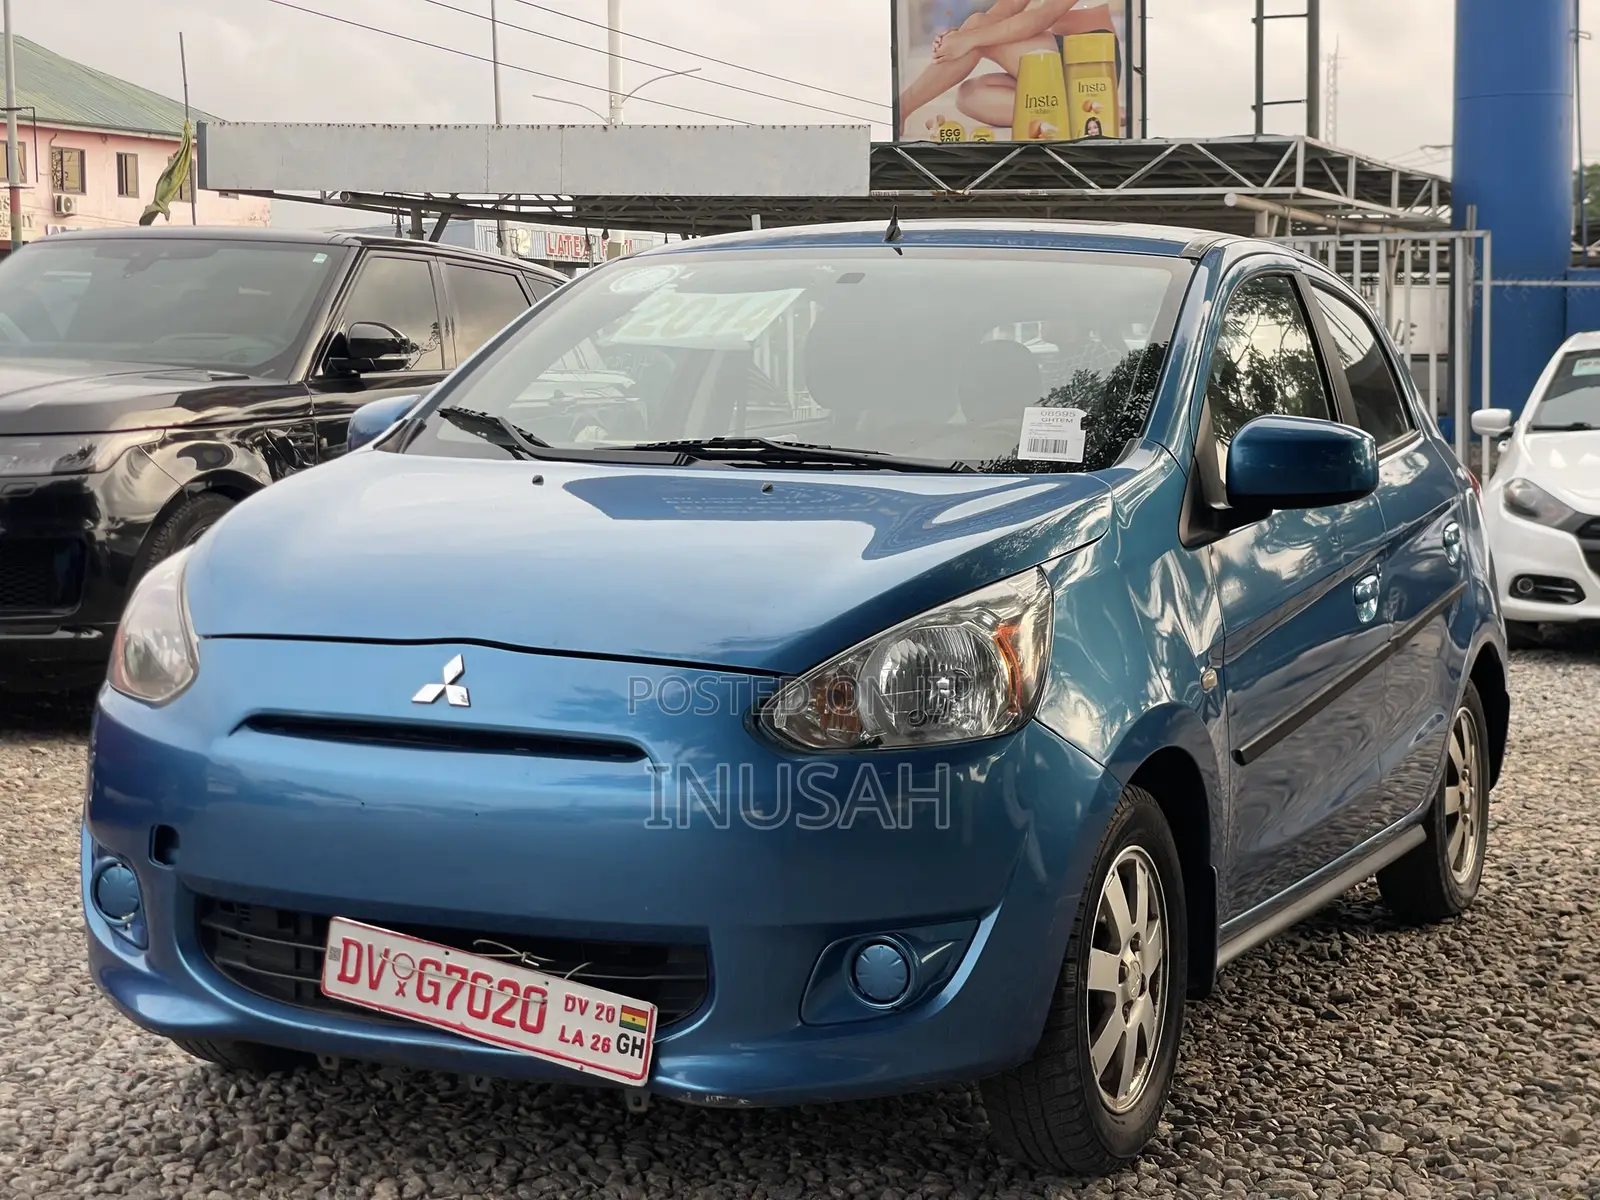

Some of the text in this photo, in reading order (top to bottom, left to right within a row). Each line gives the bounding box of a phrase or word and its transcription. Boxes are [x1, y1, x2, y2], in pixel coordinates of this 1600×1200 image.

[1078, 82, 1107, 93] Insta
[1025, 94, 1059, 109] Insta
[940, 128, 961, 138] EGG
[337, 937, 548, 1035] DV G7020
[564, 994, 616, 1023] DV 20
[558, 1025, 612, 1054] LA 26
[616, 1033, 645, 1059] GH
